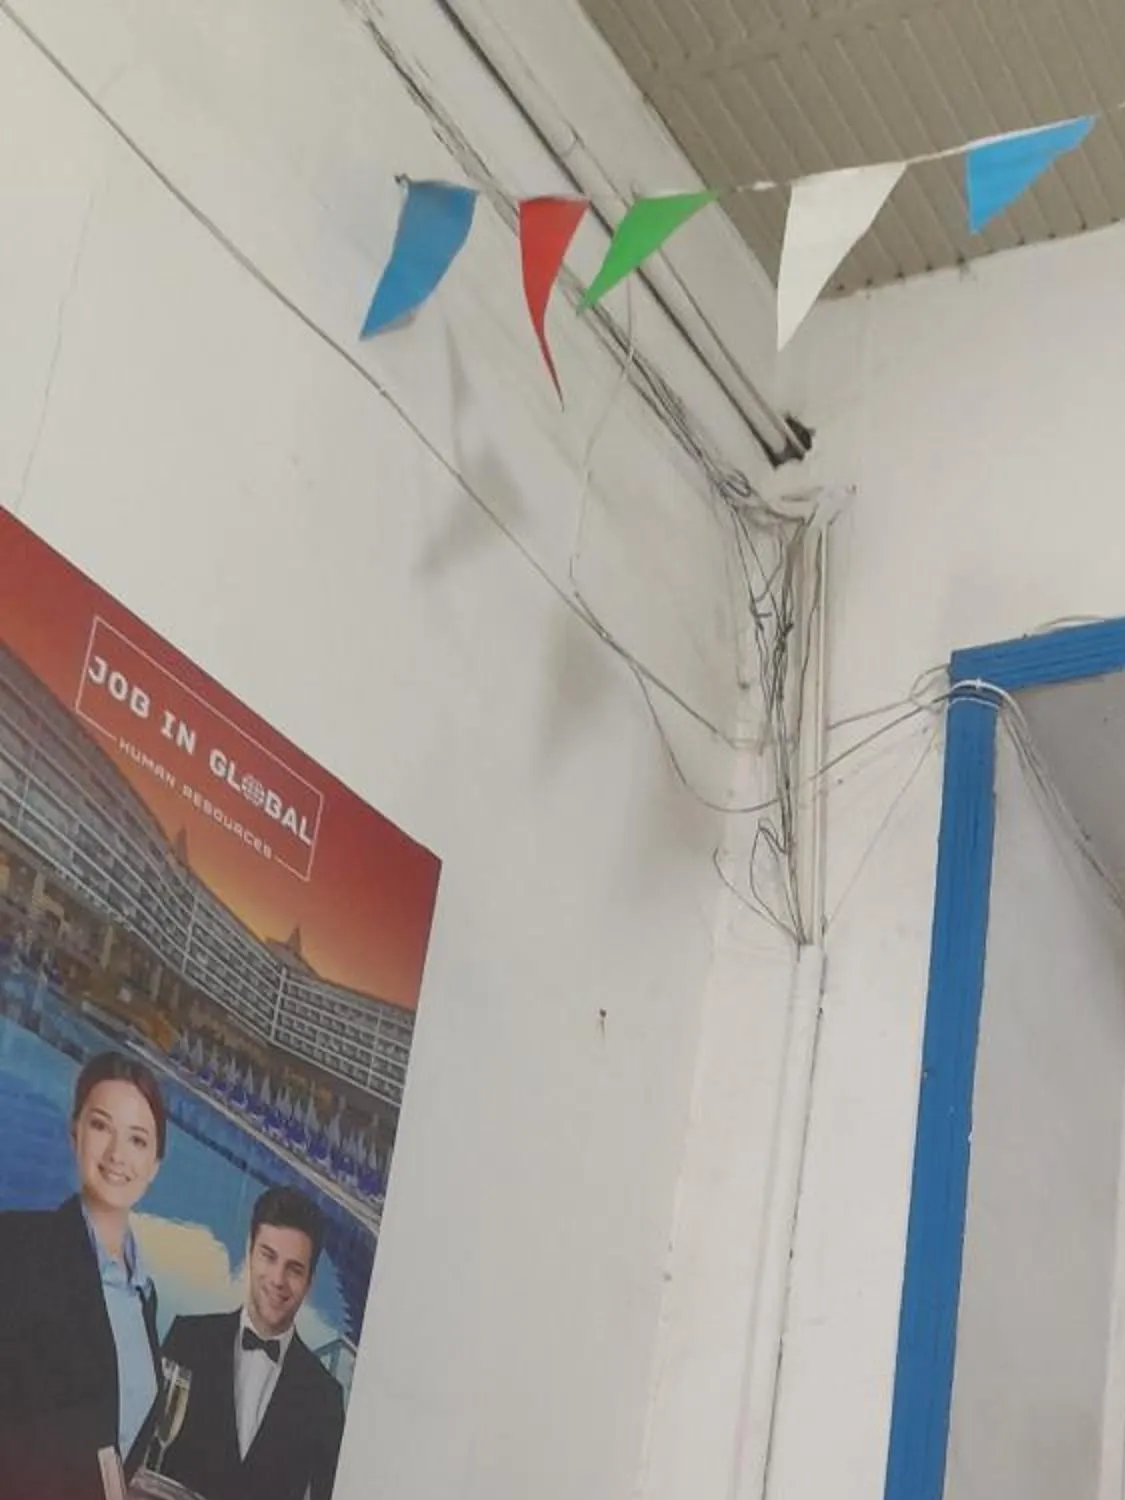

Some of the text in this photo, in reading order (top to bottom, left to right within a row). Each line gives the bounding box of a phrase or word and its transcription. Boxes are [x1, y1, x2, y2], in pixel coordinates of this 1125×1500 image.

[88, 656, 315, 846] JOB IN GLOBAL
[119, 739, 273, 860] HUMAN RESOURCES
